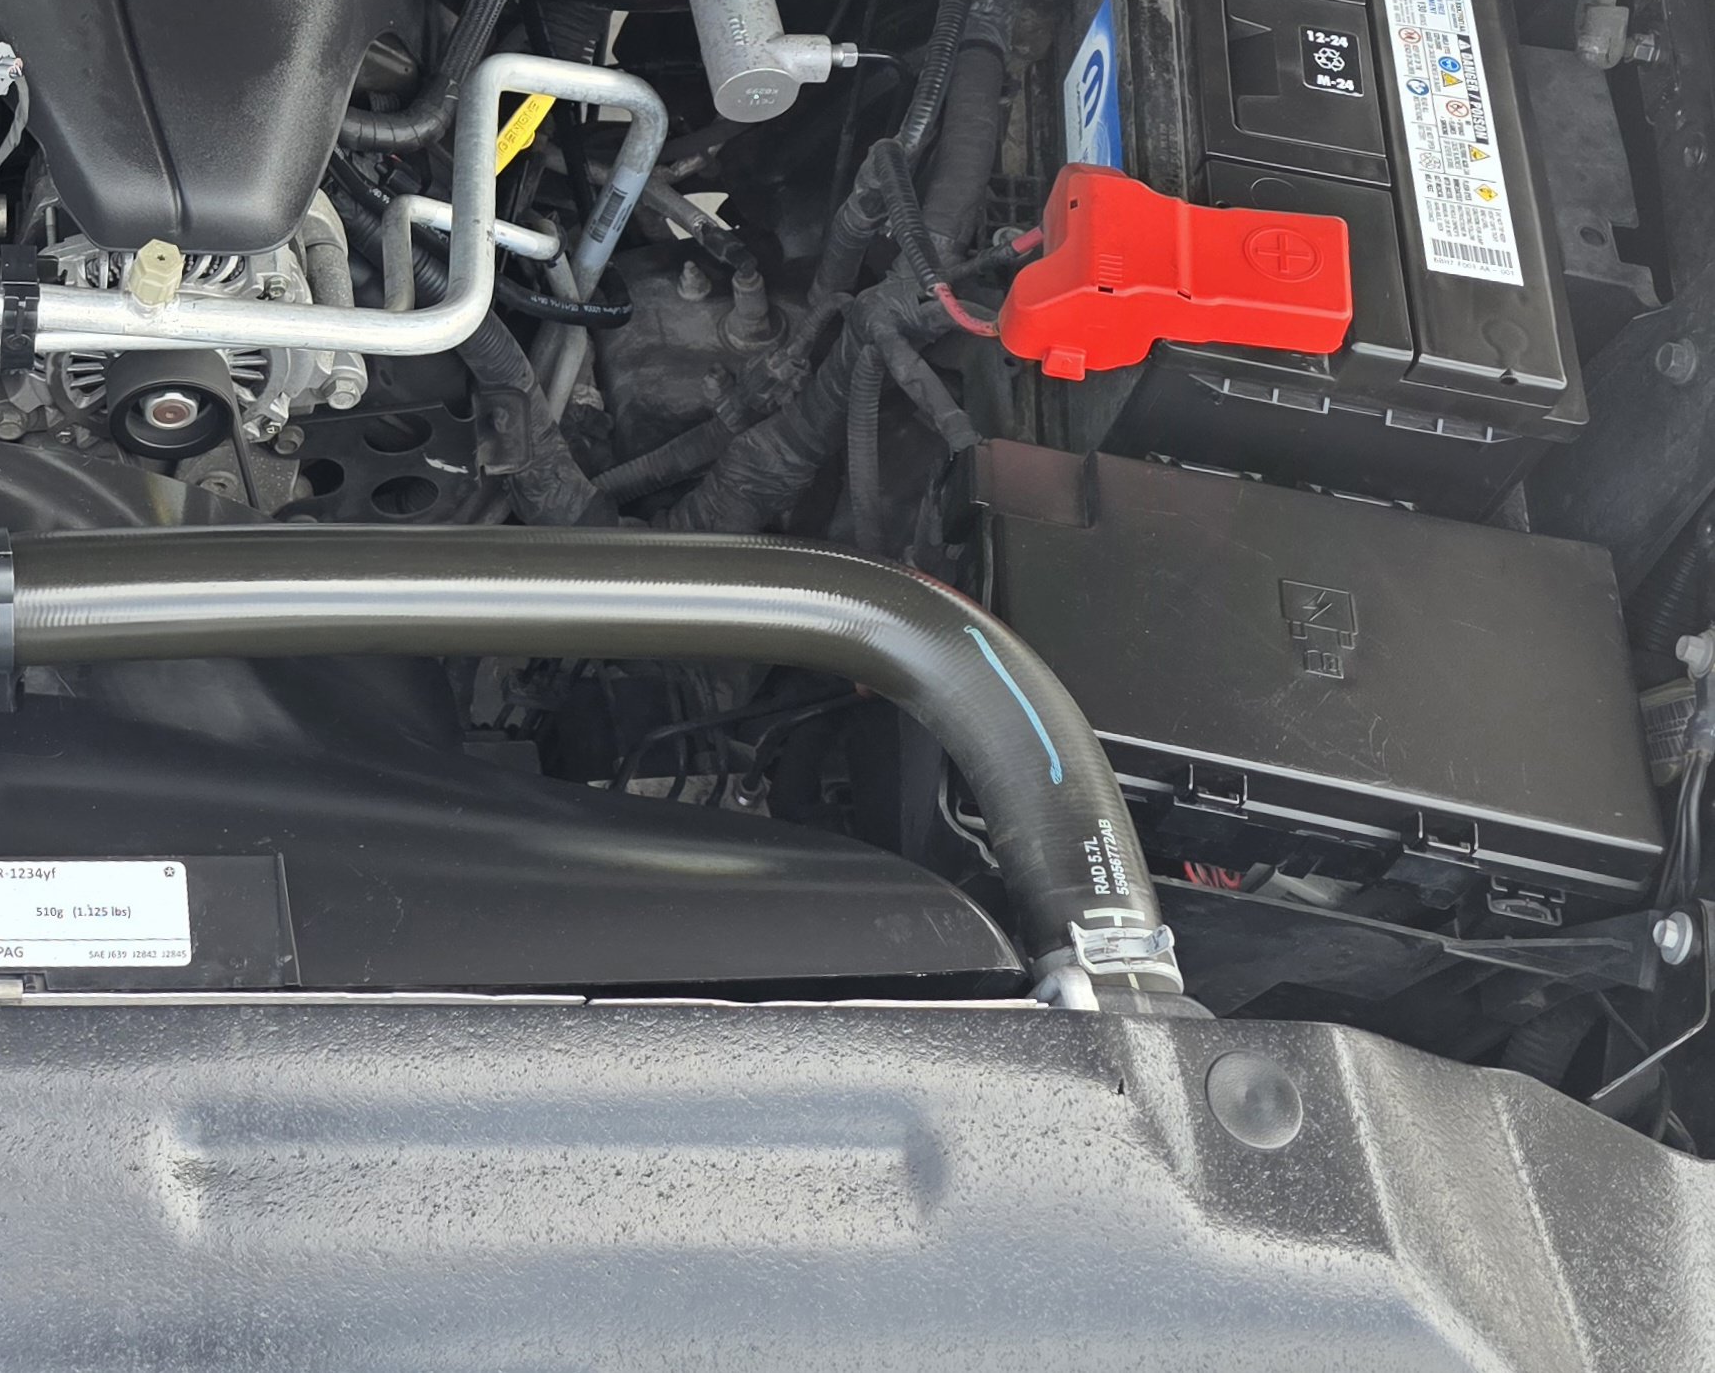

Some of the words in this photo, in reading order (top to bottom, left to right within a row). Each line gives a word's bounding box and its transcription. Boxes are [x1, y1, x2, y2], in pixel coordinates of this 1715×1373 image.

[1306, 30, 1349, 48] 12-24
[1316, 74, 1355, 91] M-24
[1460, 52, 1479, 92] DANGER
[1468, 101, 1487, 140] POISON
[1083, 836, 1103, 863] 5.7L
[1098, 818, 1130, 896] 55056772AB
[1091, 865, 1111, 895] RAD
[36, 906, 64, 919] 510g
[72, 906, 108, 919] (1.125
[111, 906, 132, 919] lbs)
[89, 950, 105, 958] SAE
[107, 950, 127, 959] J639
